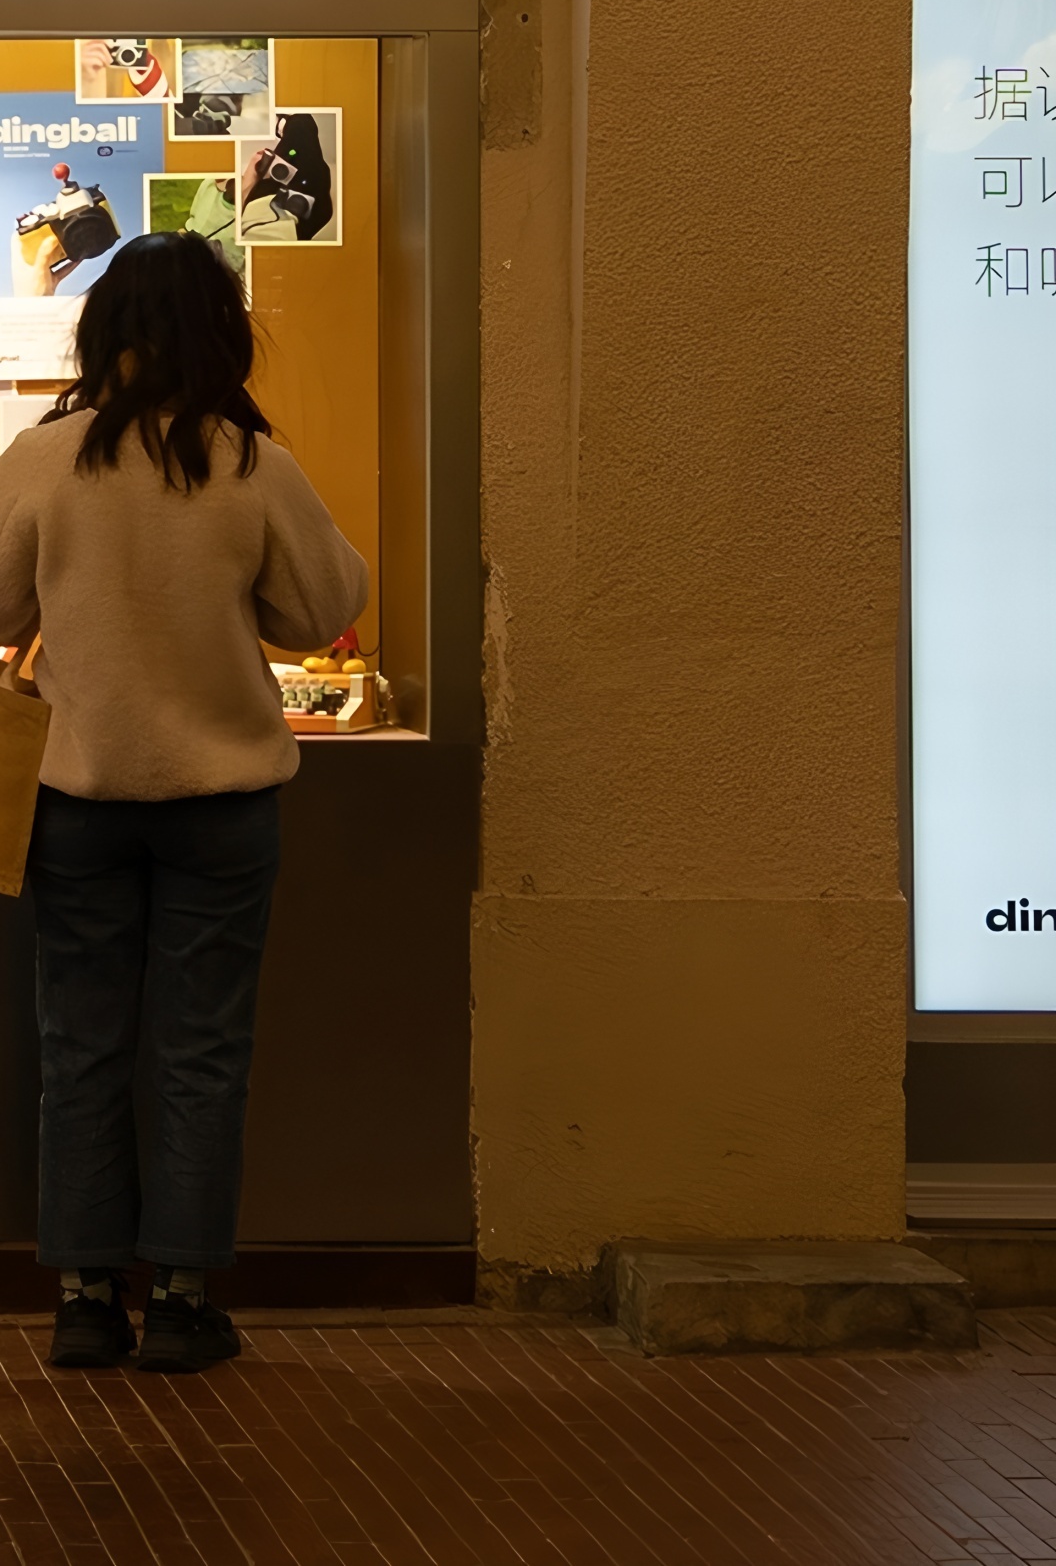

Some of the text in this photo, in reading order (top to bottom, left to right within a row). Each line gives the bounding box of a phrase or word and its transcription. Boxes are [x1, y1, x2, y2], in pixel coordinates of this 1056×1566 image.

[974, 156, 1056, 208] 可
[974, 242, 1056, 297] 和
[986, 898, 1056, 932] din
